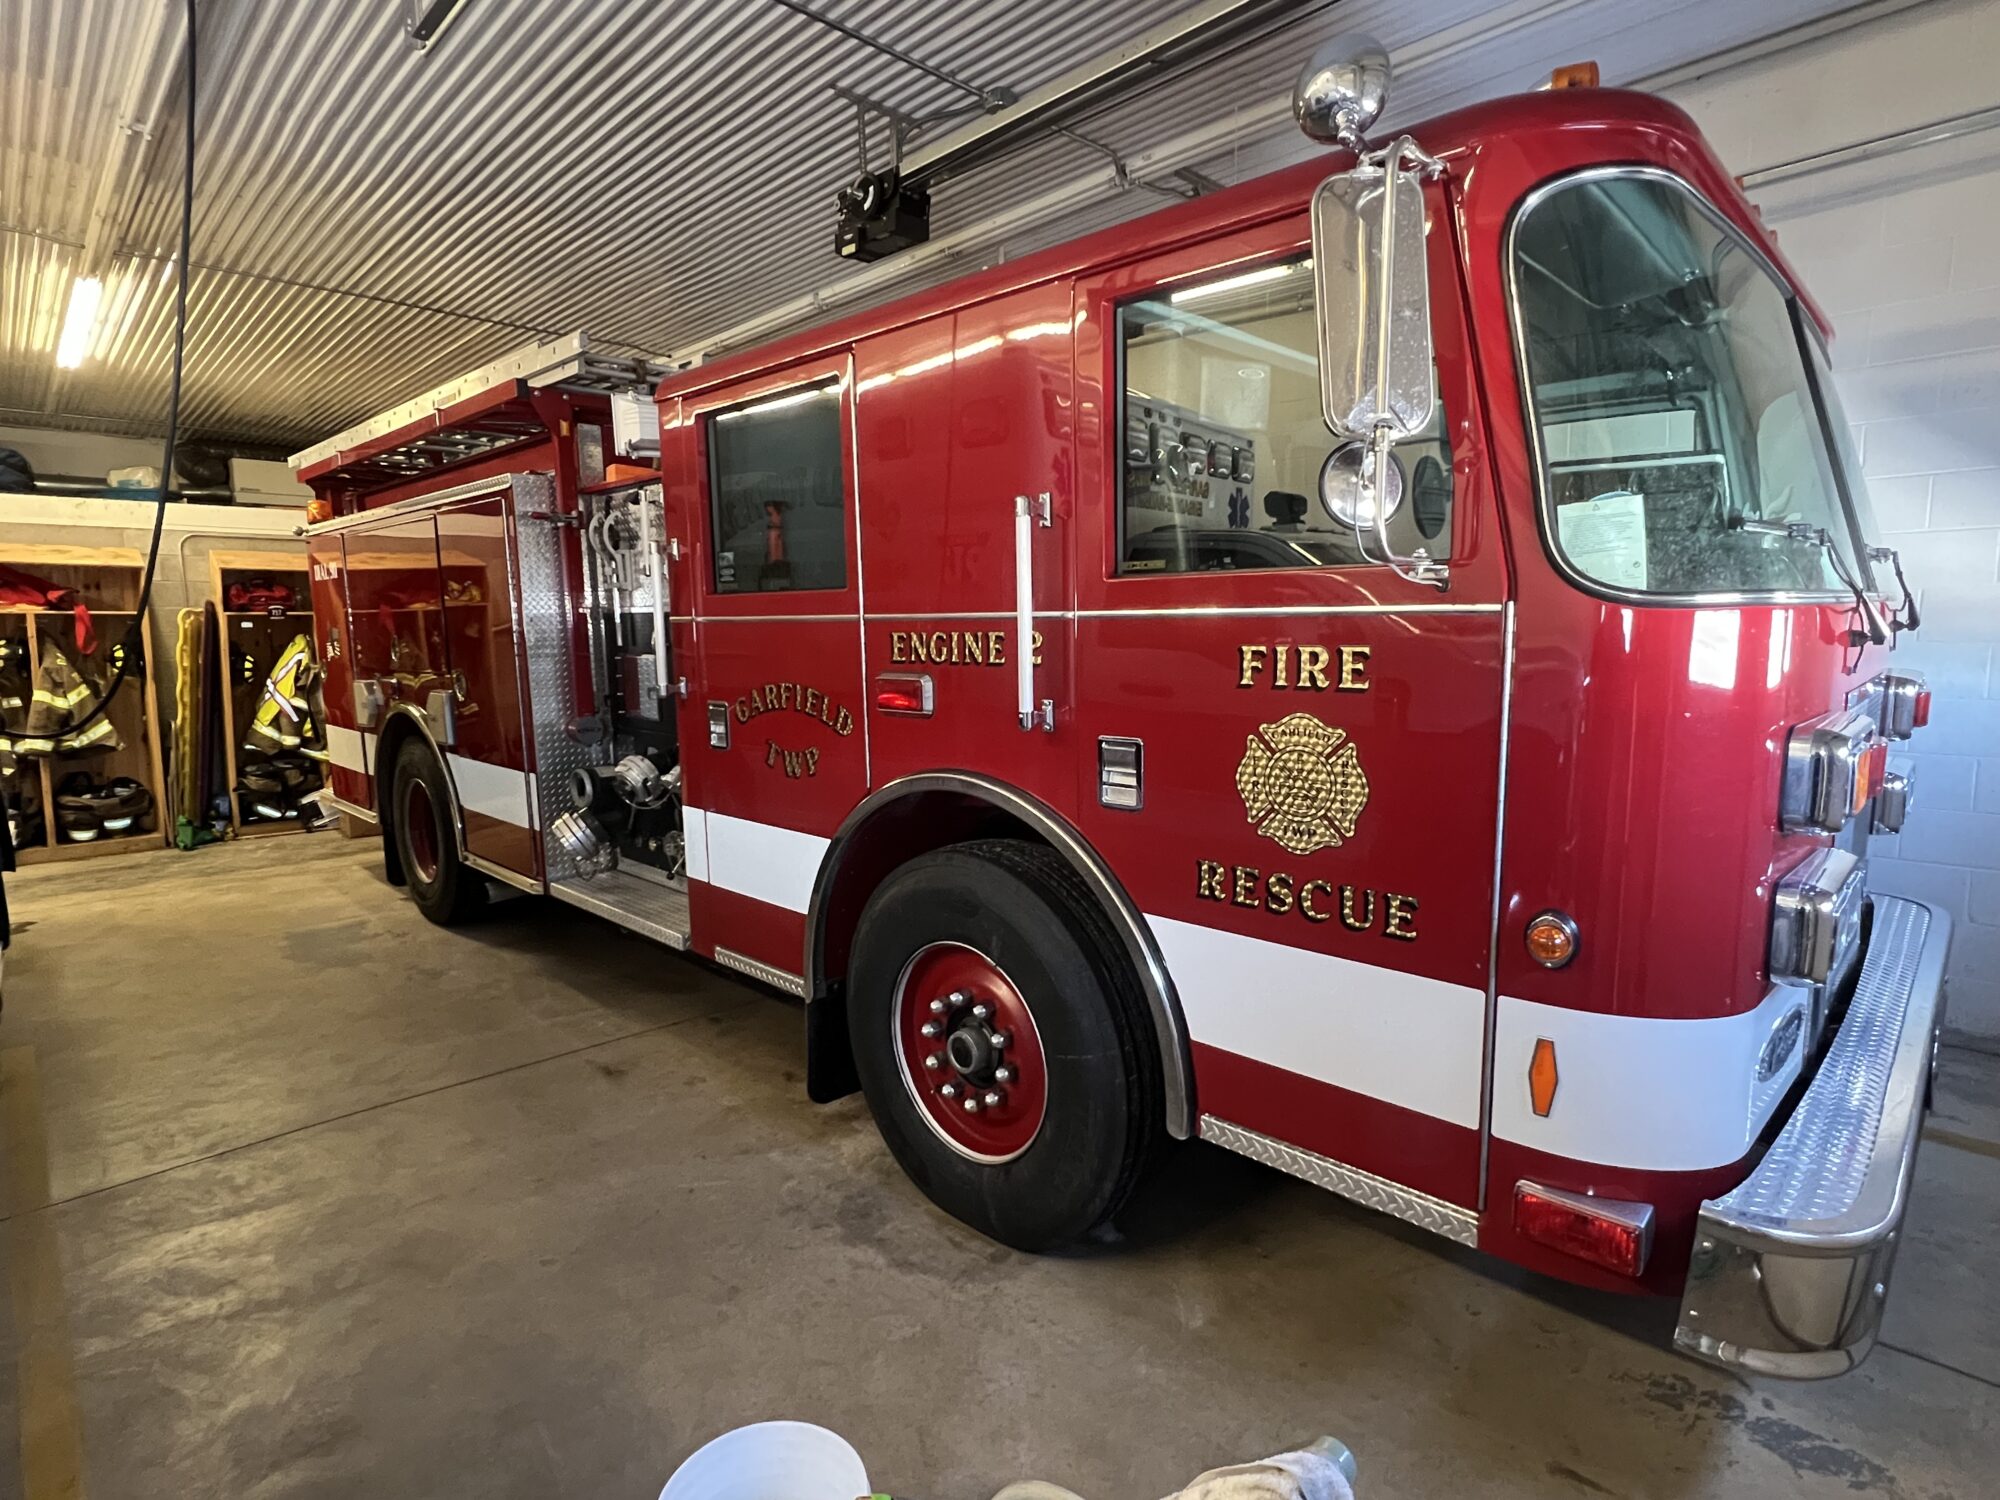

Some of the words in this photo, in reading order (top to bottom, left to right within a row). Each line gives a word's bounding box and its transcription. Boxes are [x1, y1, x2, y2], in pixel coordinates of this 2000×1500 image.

[891, 631, 1006, 665] ENGINE
[1239, 645, 1371, 690] FIRE
[735, 682, 854, 737] GARFIELD
[1271, 727, 1332, 743] GARFIELD
[766, 740, 820, 778] TWP
[1251, 756, 1260, 803] FIRE
[1282, 825, 1317, 839] TWP
[1197, 860, 1419, 939] RESCUE
